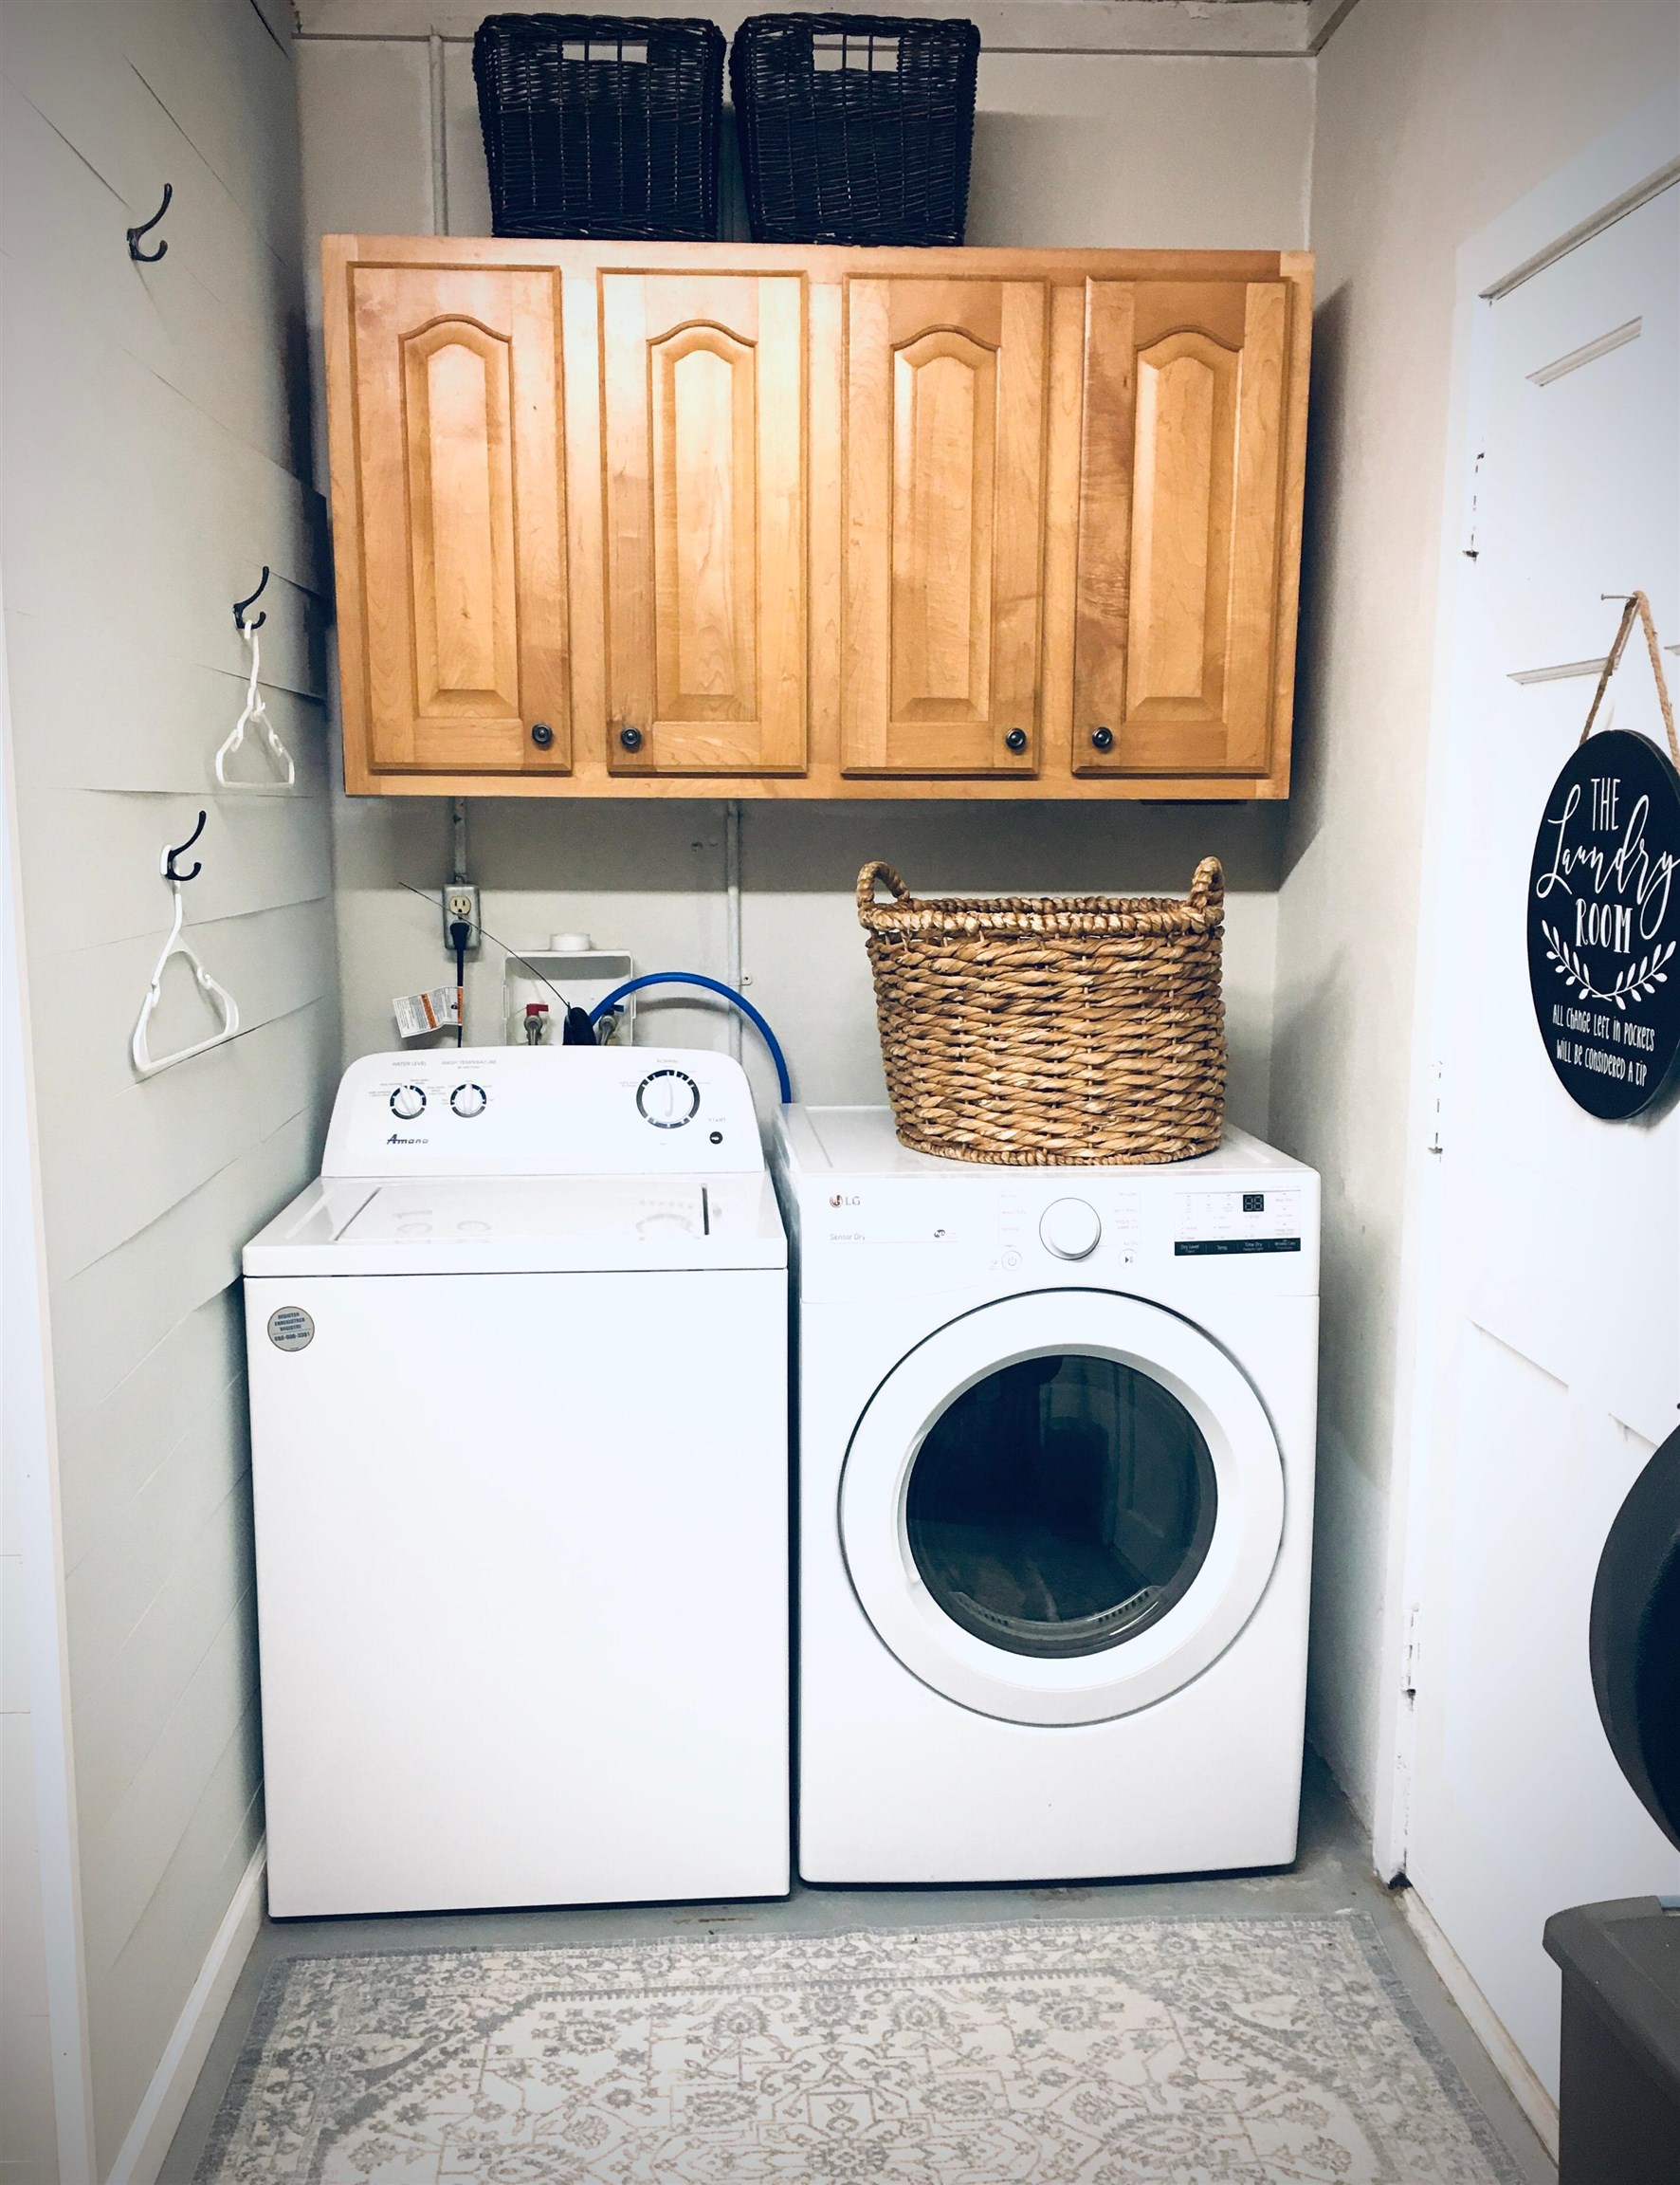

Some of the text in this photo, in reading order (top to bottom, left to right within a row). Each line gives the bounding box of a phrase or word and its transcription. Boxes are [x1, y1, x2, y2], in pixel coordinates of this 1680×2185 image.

[1591, 777, 1621, 832] THE
[1536, 783, 1680, 940] Laundry
[1575, 897, 1634, 954] ROOM
[1552, 1003, 1564, 1027] ALL
[1627, 1060, 1634, 1083] A
[386, 1133, 429, 1146] Amana
[845, 1196, 861, 1206] LG
